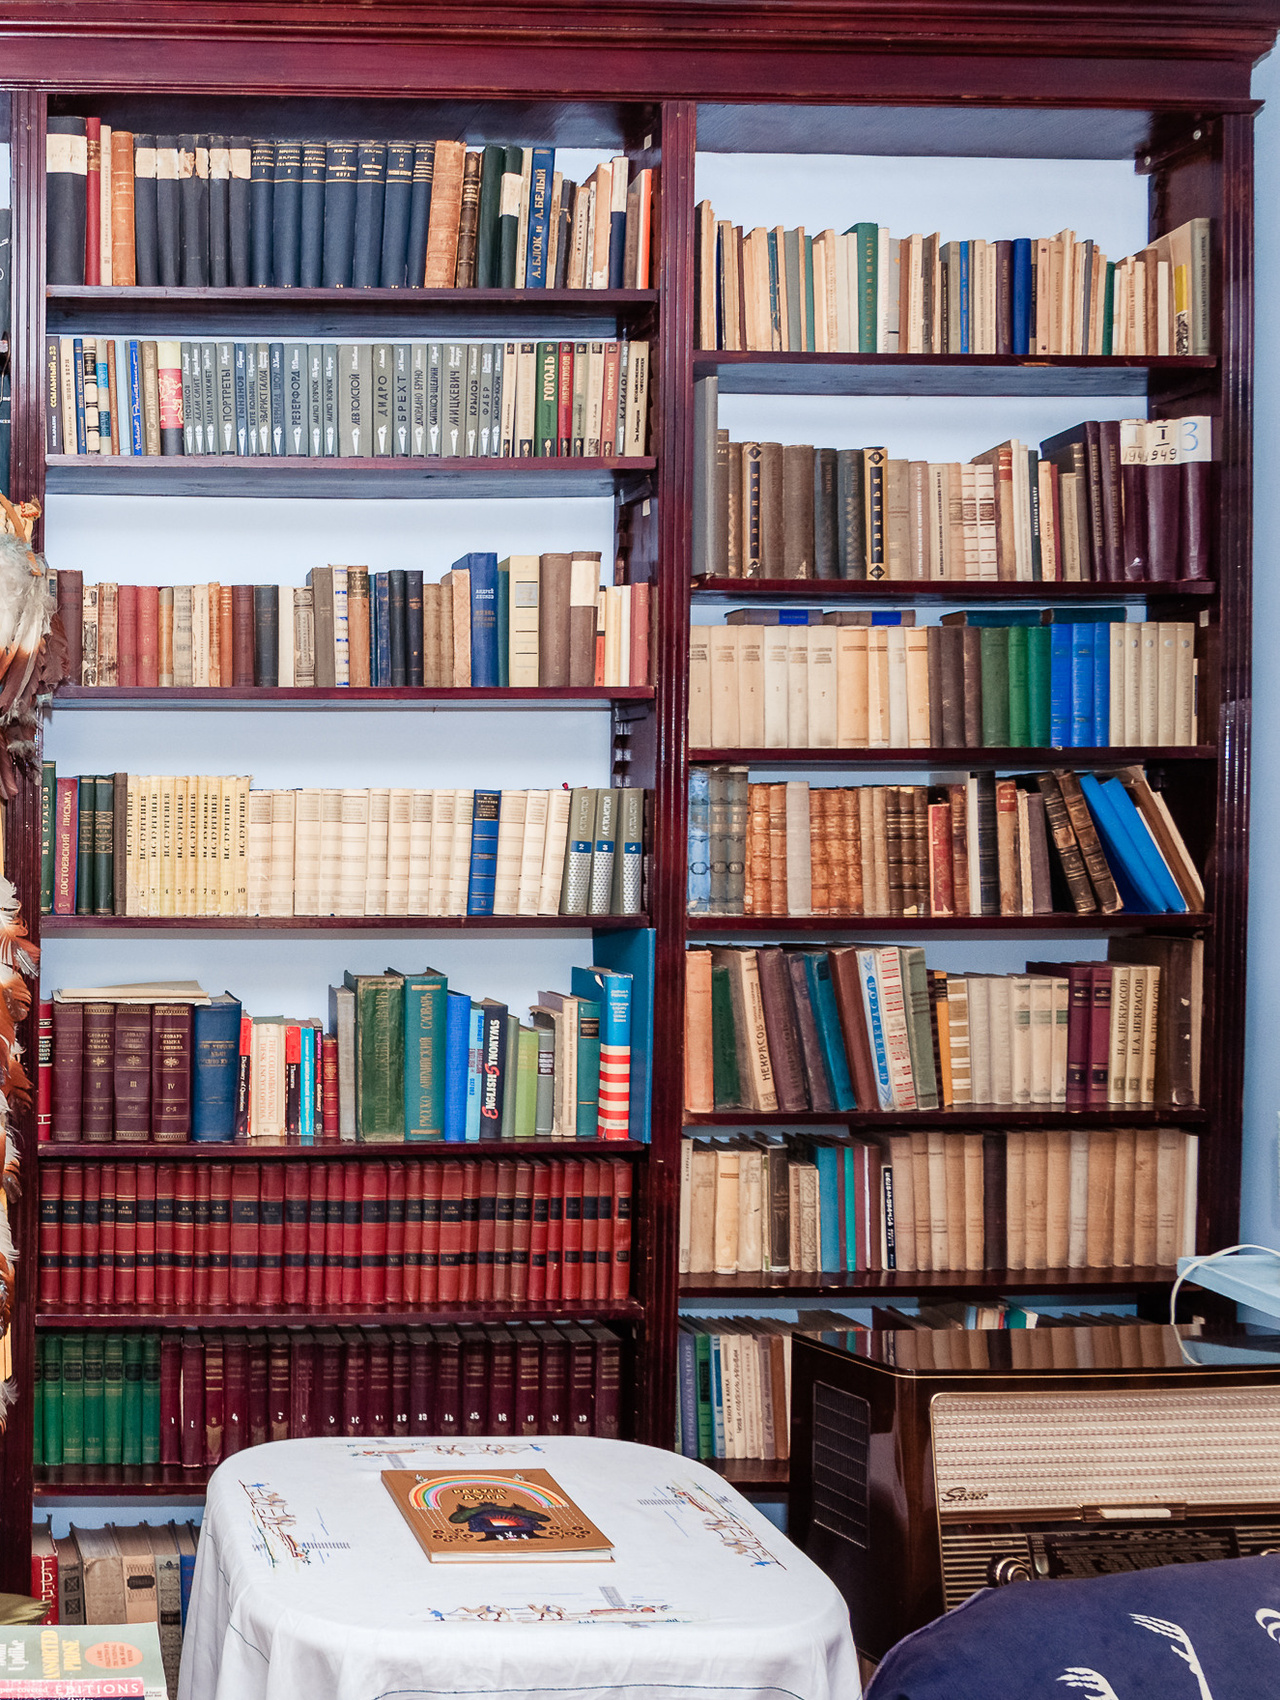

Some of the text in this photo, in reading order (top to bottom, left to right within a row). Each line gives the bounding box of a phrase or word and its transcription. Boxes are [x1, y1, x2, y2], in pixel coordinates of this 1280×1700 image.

[184, 384, 192, 420] НОВИКОВ
[193, 378, 201, 421] АДАМ СМИТ
[205, 370, 214, 425] НАЗЫМ ХИКМЕТ
[221, 369, 232, 421] ПОРТРЕТЫ
[237, 376, 245, 419] ТЫНЯНОВ
[259, 370, 268, 423] ЭВАРИСТ ГАЛУА
[273, 373, 282, 424] БЕРНАРД ШОУ
[291, 370, 301, 426] РЕЗЕРФОРД
[349, 374, 360, 426] ЛЕВ ТОЛСТОЙ
[378, 375, 388, 417] ДИДРО
[397, 376, 407, 422] БРЕХТ
[415, 370, 423, 426] ДЖОРДАНО БРУНО
[428, 367, 438, 425] САЛТЫКОВ-ЩЕДРИН
[449, 371, 460, 426] МИЦКЕВИЧ
[470, 380, 478, 416] КРЫЛОВ
[482, 386, 490, 415] ФАБР
[544, 356, 555, 401] ГОГОЛЬ
[561, 356, 570, 406] ДОБРОЛЮБОВ
[607, 362, 615, 401] ВОРОВСКИЙ
[619, 373, 628, 420] КАТАЛОГ
[873, 453, 880, 461] 9
[1182, 422, 1199, 451] 3
[873, 478, 881, 552] ЗВЕНЬЯ
[1091, 443, 1103, 547] НЕКРАСОВСКИЙ СБОРНИК
[42, 786, 50, 832] СТАСОВ
[60, 791, 72, 897] ДОСТОЕВСКИЙ ПИСЬМА
[867, 980, 885, 1055] НЕКРАСОВ
[482, 1020, 500, 1119] ENGLISH SYNONYMS
[755, 1024, 771, 1081] НЕКРАСОВ
[40, 1630, 61, 1679] ASSORTED
[61, 1639, 82, 1671] PROSE
[17, 1685, 48, 1694] covered
[55, 1683, 140, 1695] EDITIONS
